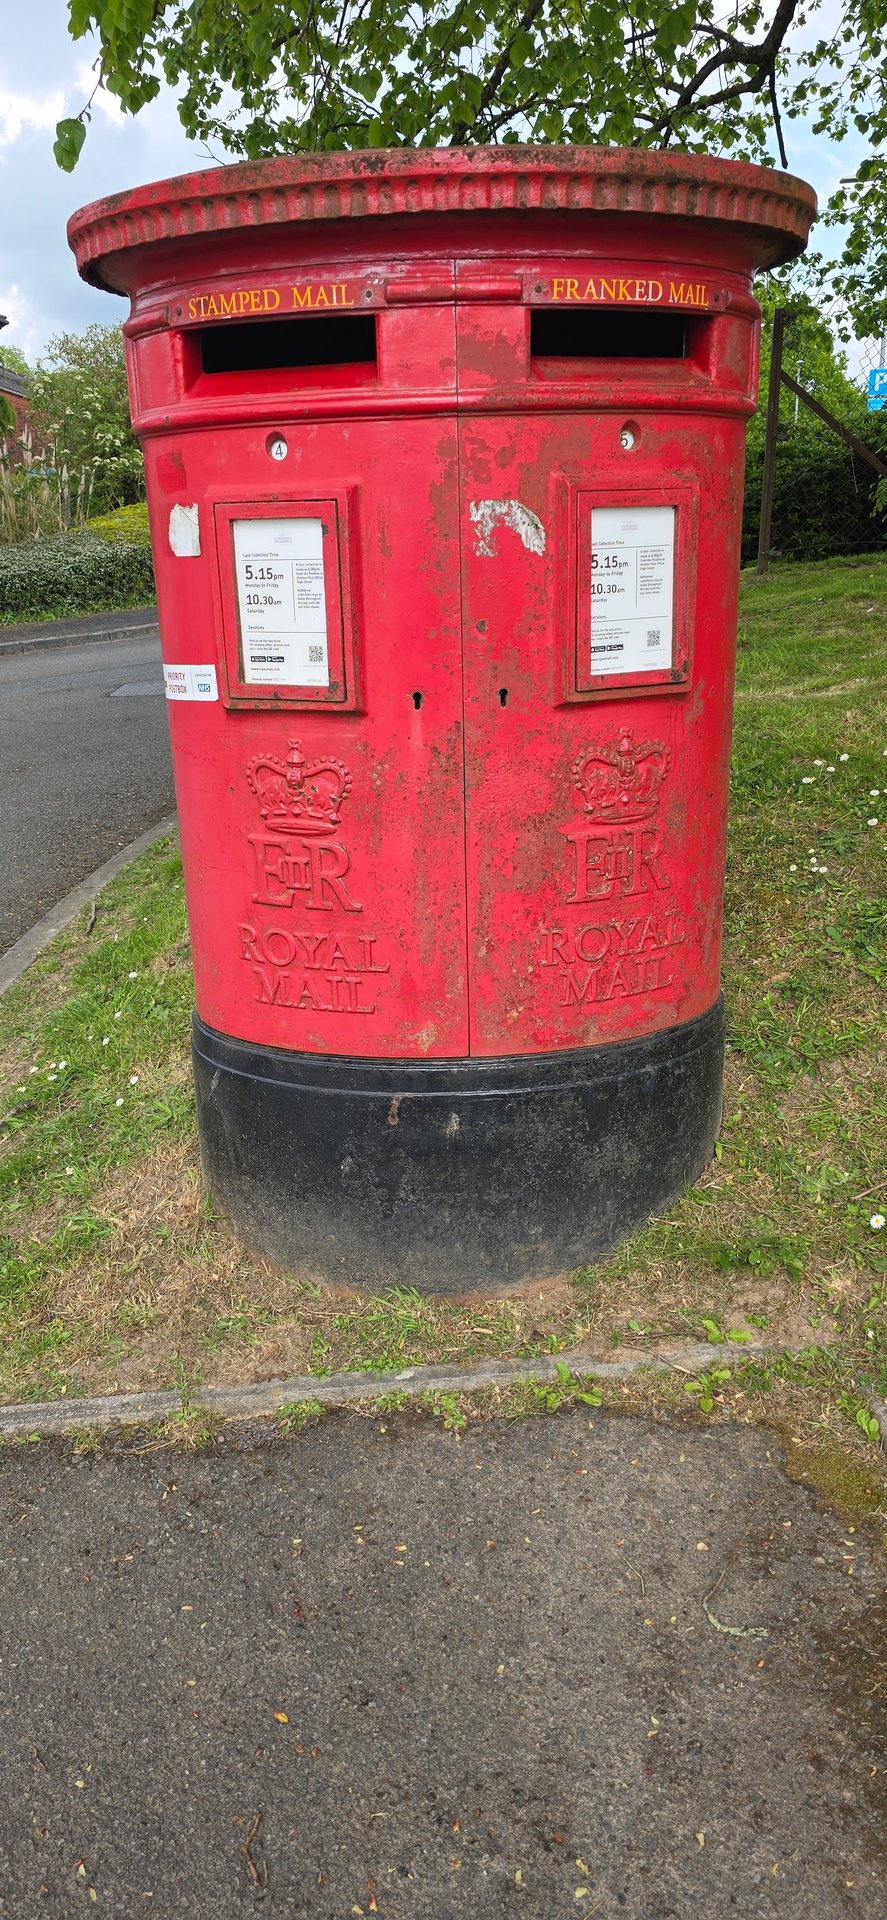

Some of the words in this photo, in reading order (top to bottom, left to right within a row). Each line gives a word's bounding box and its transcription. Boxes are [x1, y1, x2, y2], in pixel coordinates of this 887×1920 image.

[552, 278, 663, 302] FRANKED
[668, 282, 709, 306] MAIL
[188, 289, 281, 319] STAMPED
[291, 284, 355, 309] MAIL
[620, 432, 628, 447] 5
[275, 443, 284, 457] 4
[591, 554, 629, 569] 5.15pm
[245, 564, 284, 581] 5.15pm
[591, 583, 625, 595] 10.30am
[246, 594, 282, 606] 10.30am
[198, 683, 211, 692] NHS
[541, 910, 686, 967] ROYAL
[238, 922, 391, 973] ROYAL
[559, 953, 675, 1007] MAIL
[252, 966, 376, 1014] MAIL
